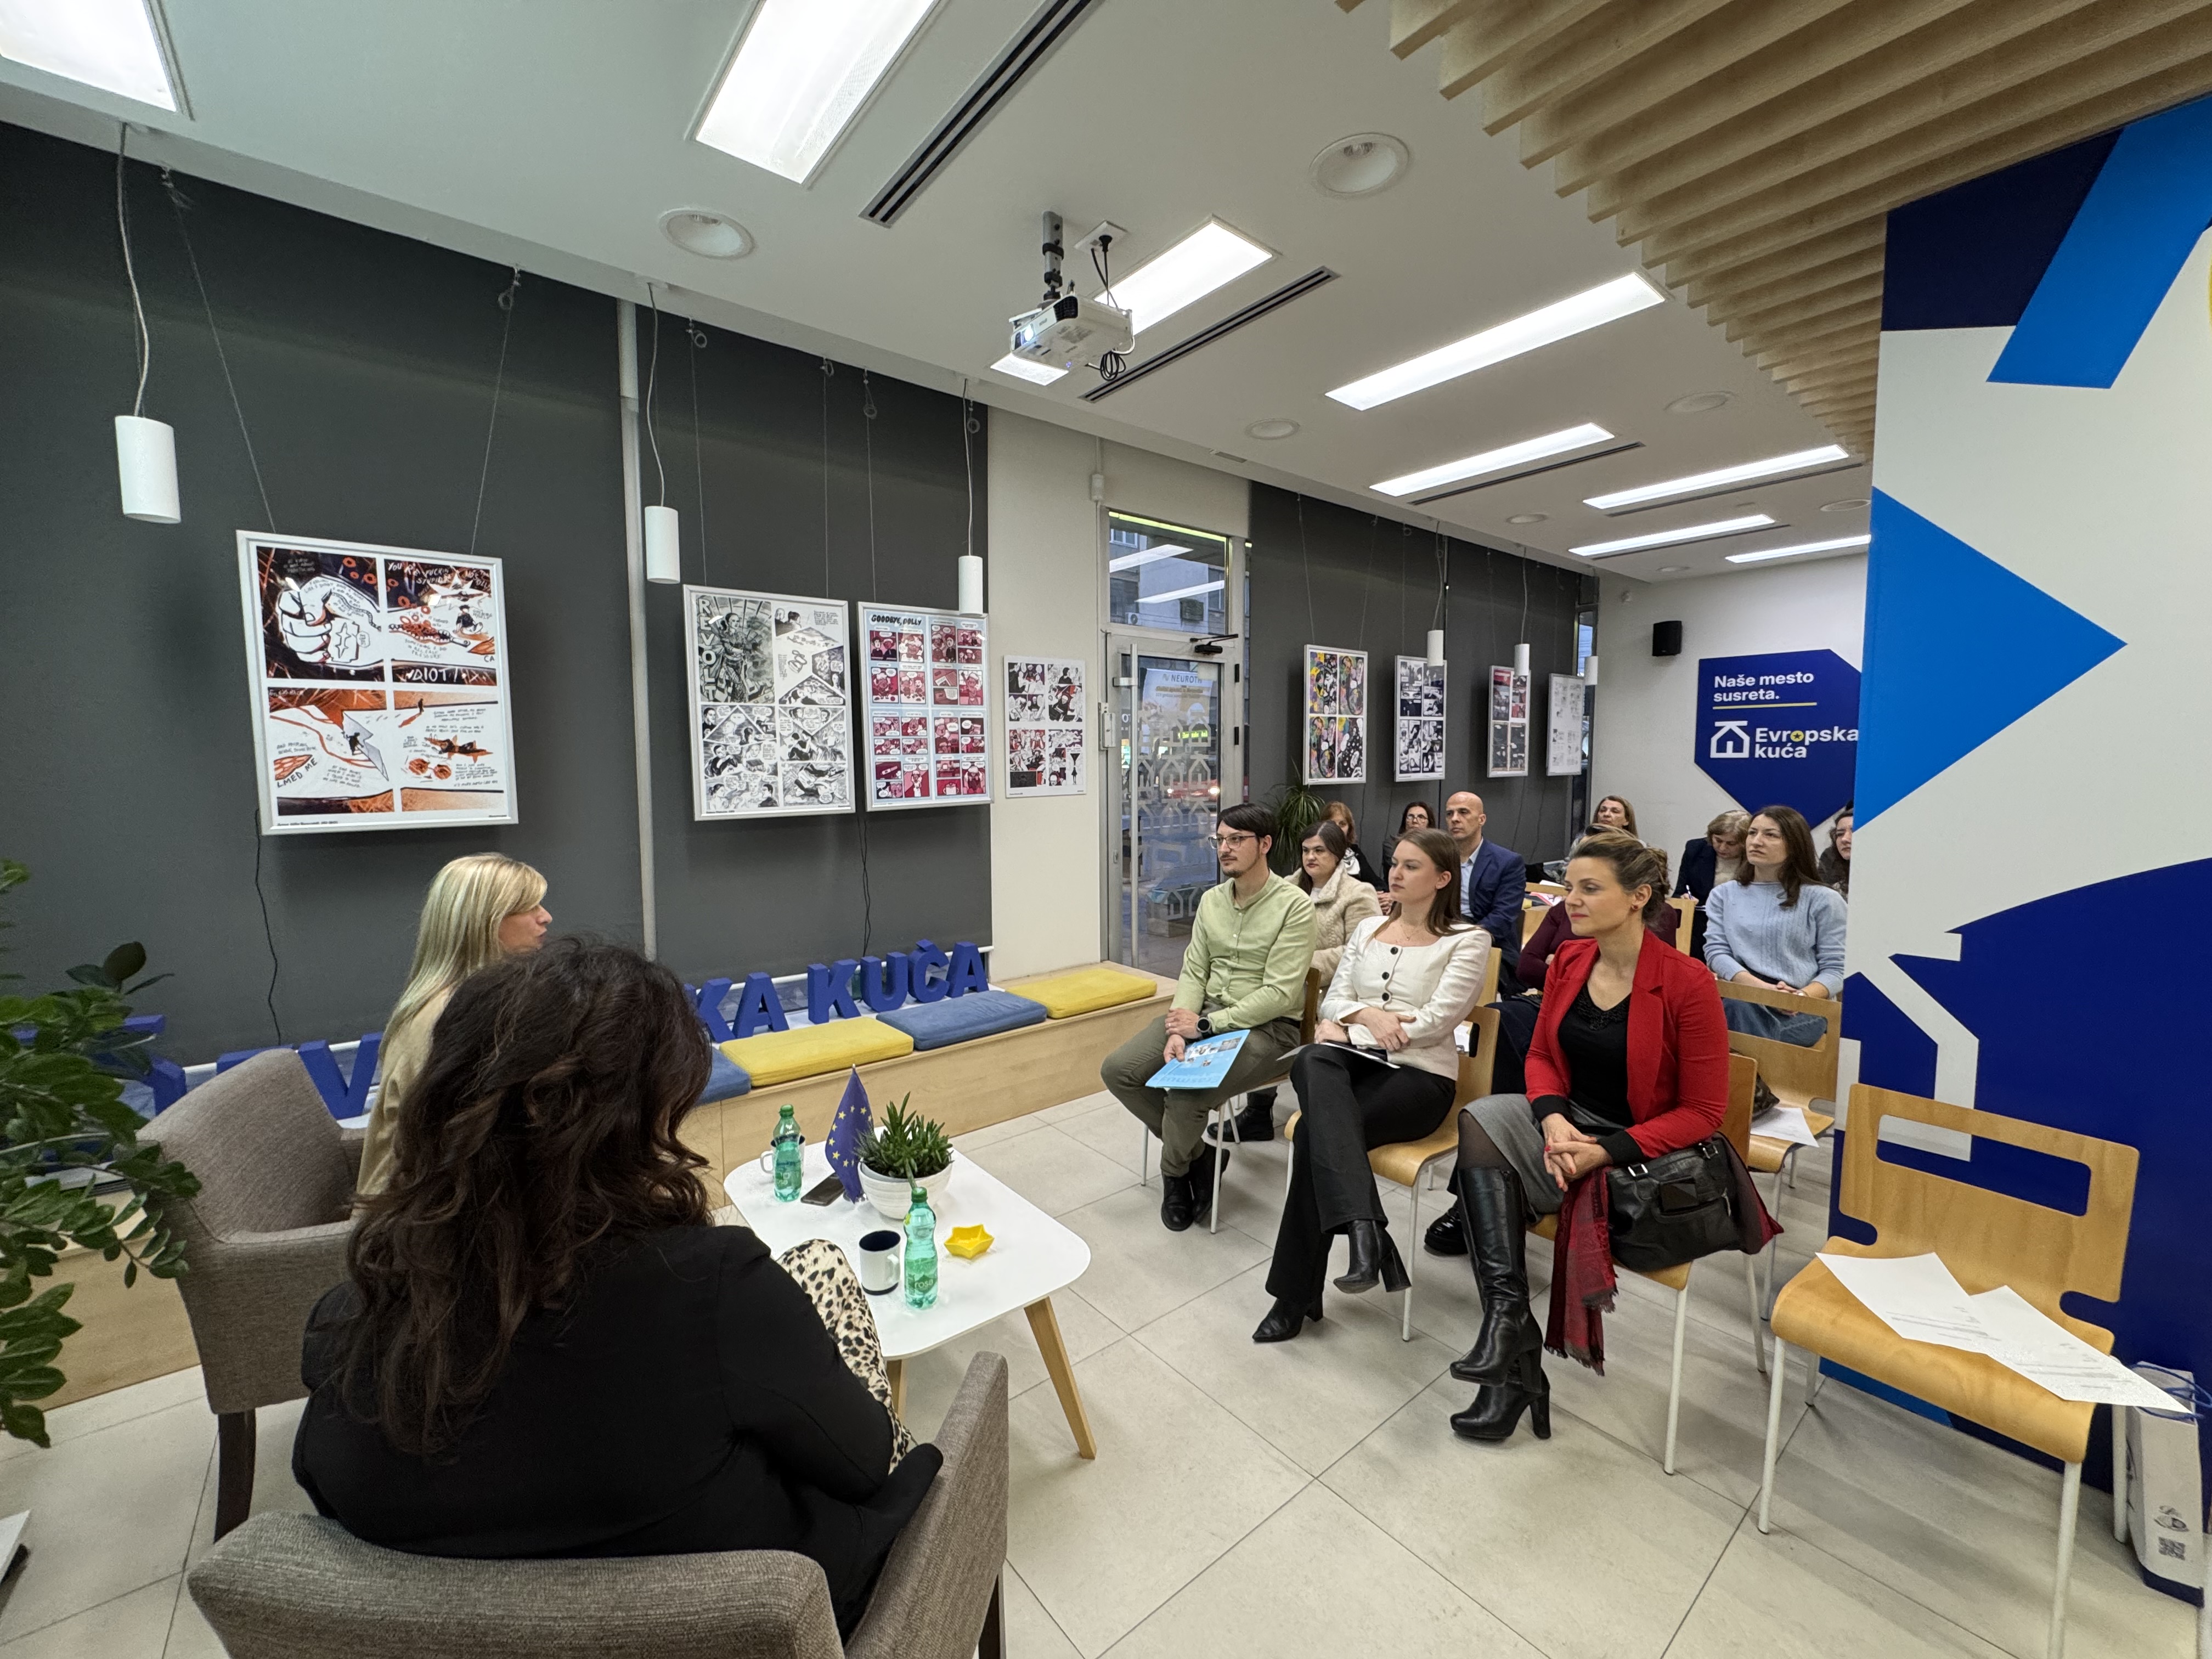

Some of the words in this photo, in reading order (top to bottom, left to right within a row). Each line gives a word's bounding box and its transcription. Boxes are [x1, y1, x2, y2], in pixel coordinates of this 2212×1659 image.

[387, 561, 403, 571] YOU
[871, 614, 902, 626] GOODBYE,
[902, 618, 922, 626] DOLLY
[698, 598, 716, 702] REVOLT
[1714, 674, 1756, 689] Naše
[1759, 672, 1814, 686] mesto
[1713, 689, 1780, 702] susreta.
[1755, 726, 1859, 746] Evropska
[1754, 743, 1807, 759] kuća
[306, 758, 318, 772] ME
[914, 1279, 934, 1289] rosa
